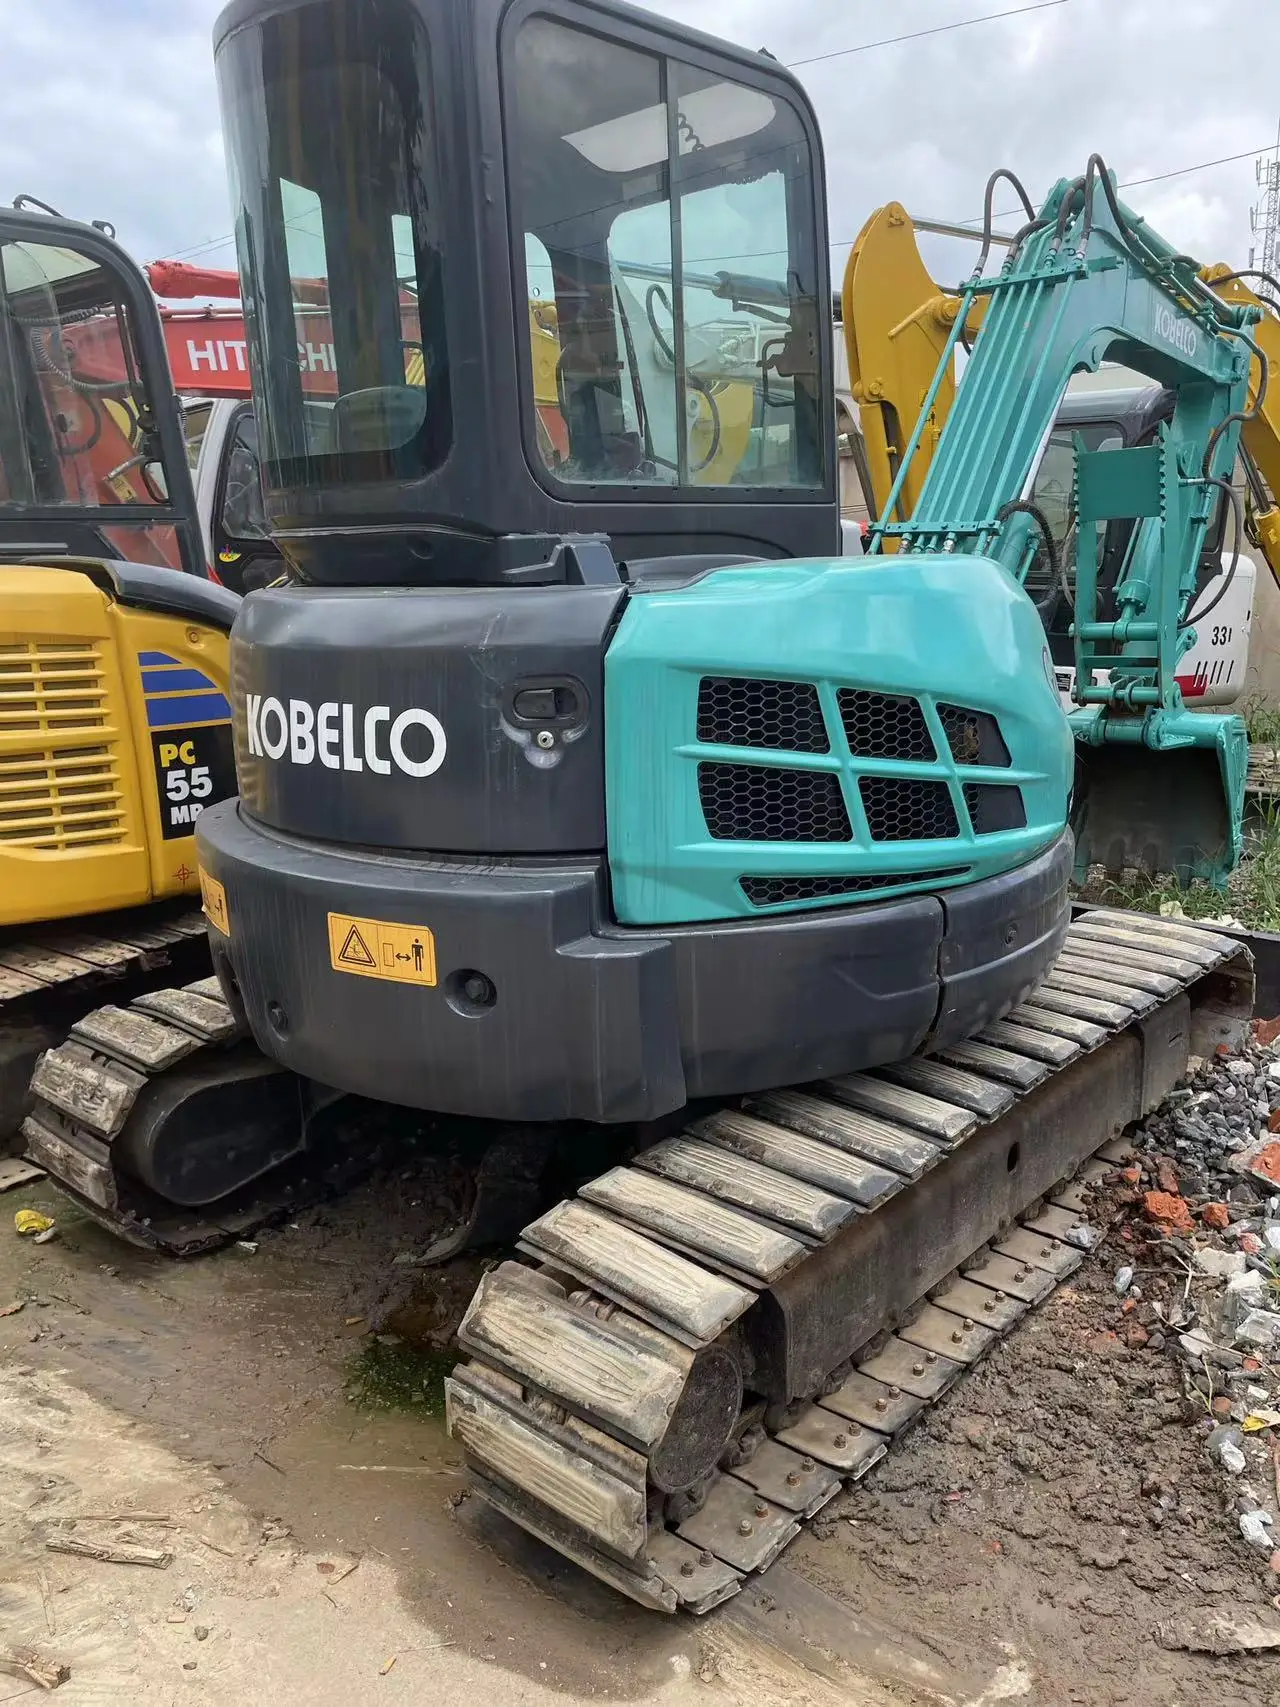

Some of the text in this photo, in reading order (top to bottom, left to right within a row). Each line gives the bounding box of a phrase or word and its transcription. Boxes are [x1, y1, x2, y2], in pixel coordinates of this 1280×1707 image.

[1154, 303, 1197, 357] KOBELCO
[186, 339, 337, 372] HITHI
[246, 693, 447, 778] KOBELCO
[159, 741, 196, 768] PC
[166, 766, 213, 801] 55
